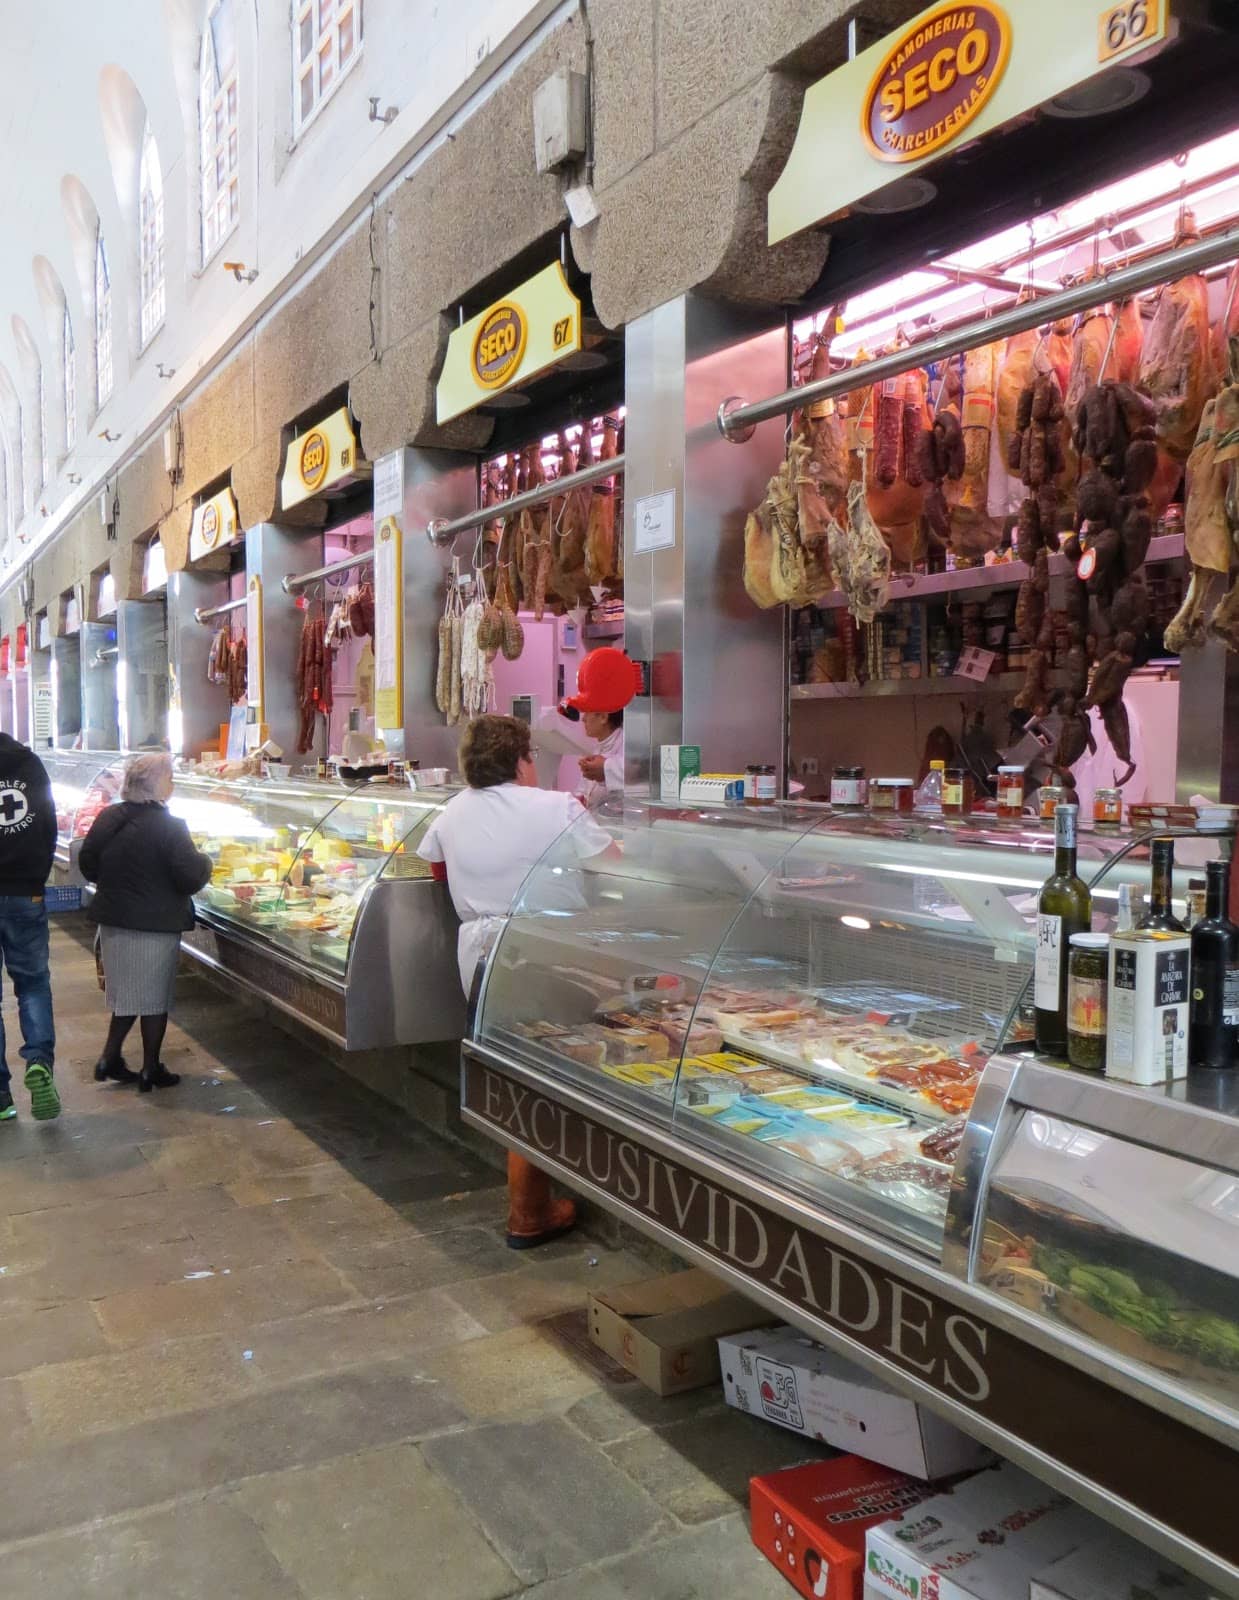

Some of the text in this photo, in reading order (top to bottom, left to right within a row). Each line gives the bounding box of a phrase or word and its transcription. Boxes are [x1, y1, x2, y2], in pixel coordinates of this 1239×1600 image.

[890, 12, 976, 76] JAMONERIAS
[1106, 0, 1147, 49] 66
[880, 28, 989, 122] SECO
[883, 76, 987, 150] CHARCUTERIAS
[479, 322, 516, 367] SECO
[554, 317, 570, 346] 67
[303, 444, 322, 473] SECO
[4, 812, 36, 835] PATROL
[483, 1069, 991, 1401] EXCLUSIVIDADES
